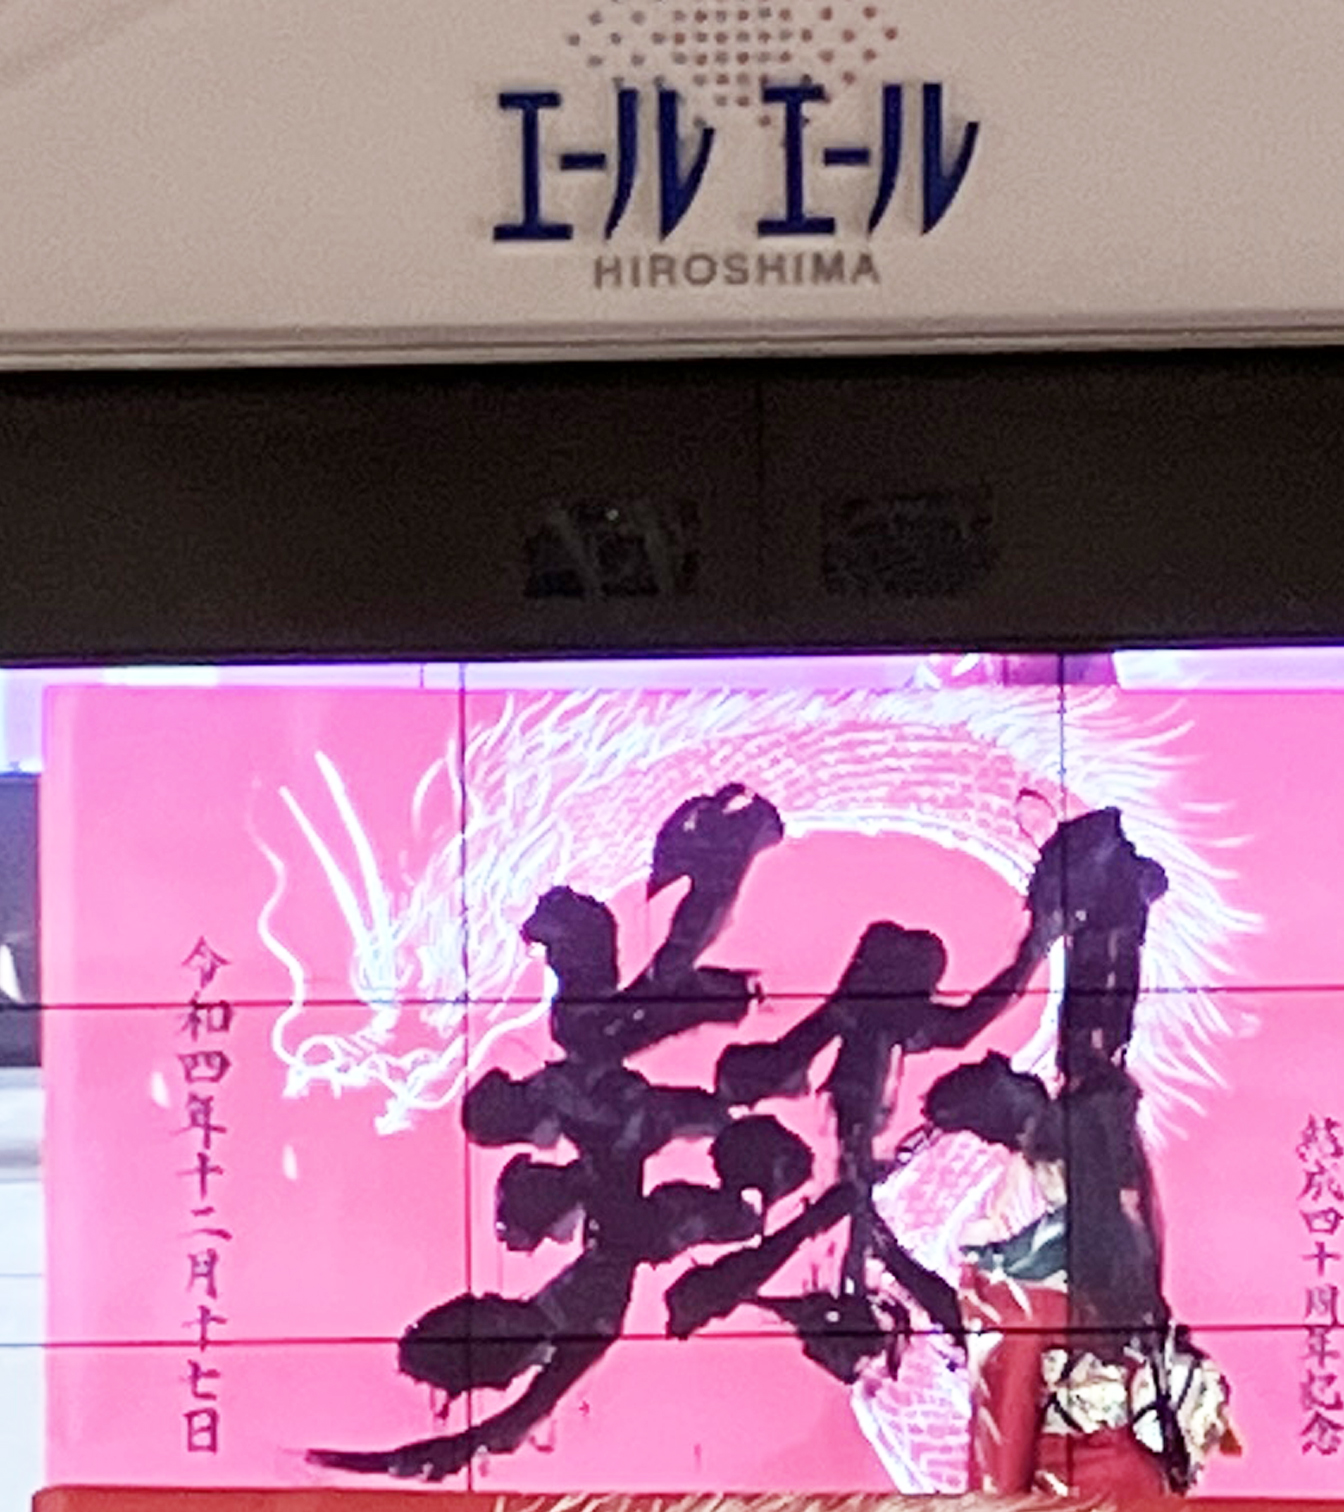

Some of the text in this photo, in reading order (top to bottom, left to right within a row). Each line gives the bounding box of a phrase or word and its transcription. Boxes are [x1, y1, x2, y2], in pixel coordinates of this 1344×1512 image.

[593, 250, 881, 290] HIROSHIMA
[172, 935, 234, 1456] 令和四年十二月十七日
